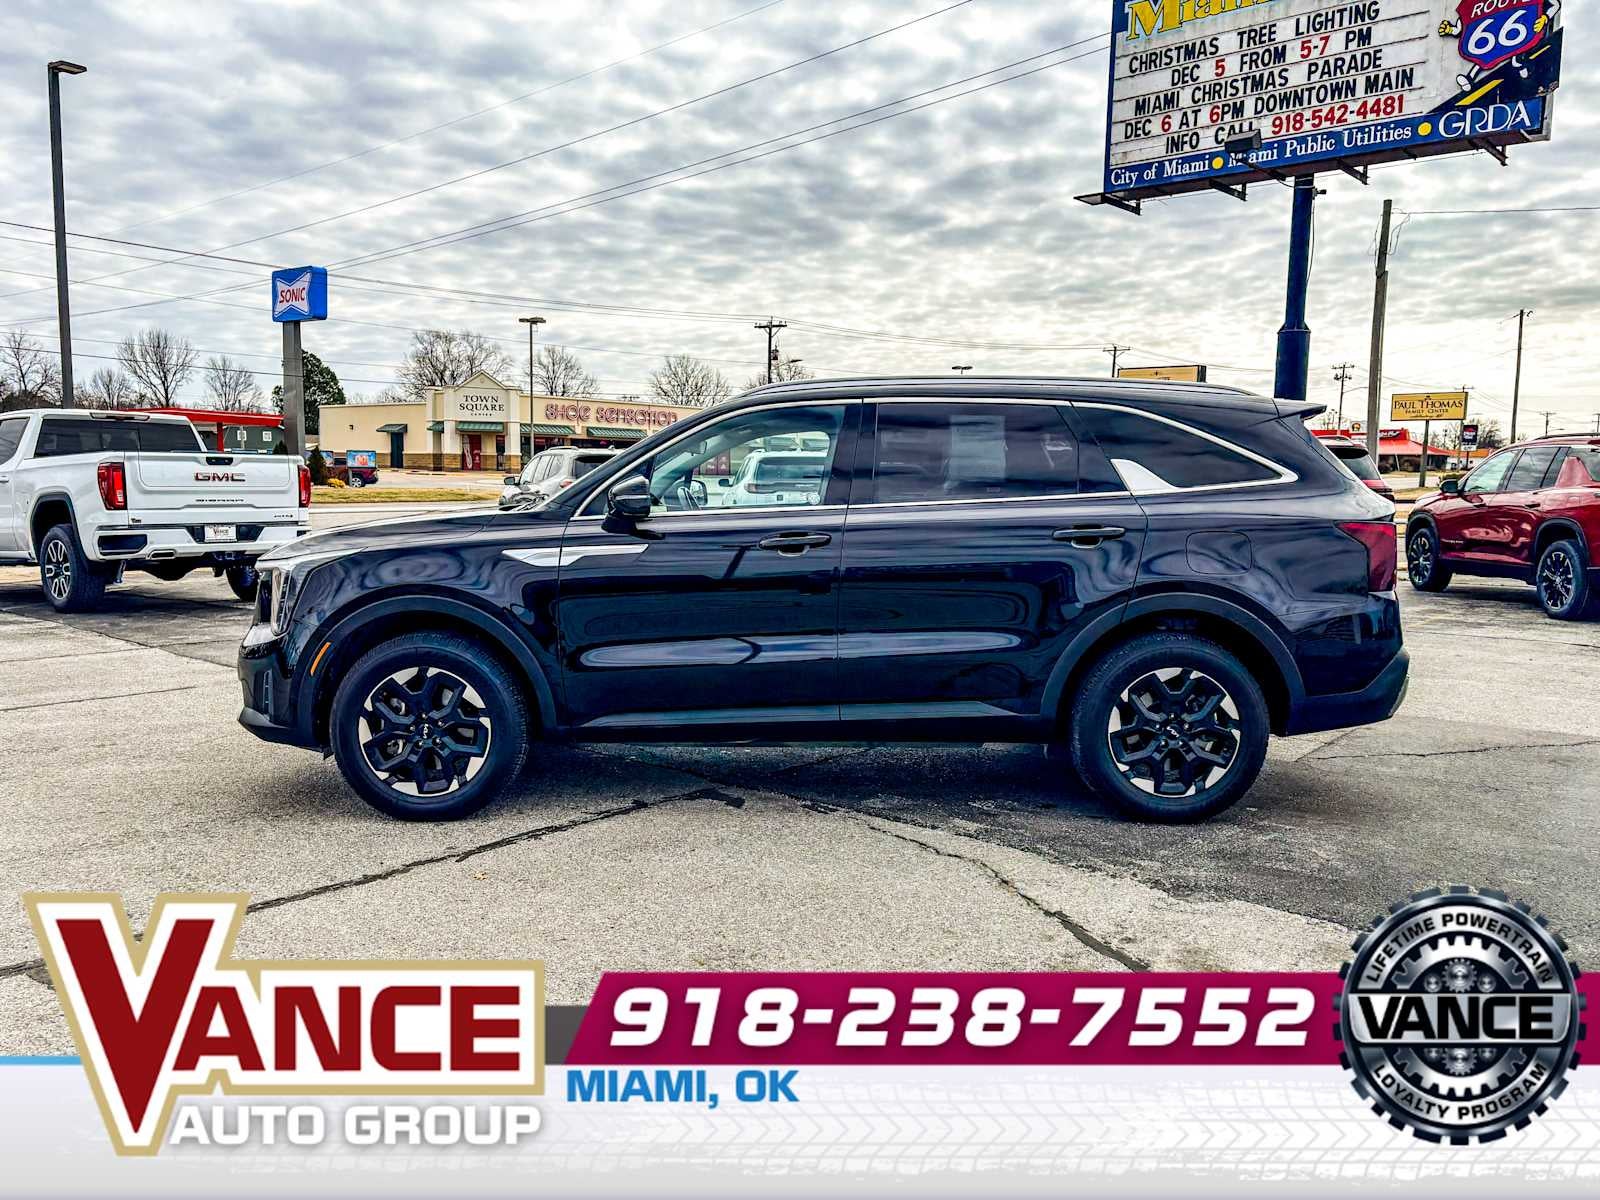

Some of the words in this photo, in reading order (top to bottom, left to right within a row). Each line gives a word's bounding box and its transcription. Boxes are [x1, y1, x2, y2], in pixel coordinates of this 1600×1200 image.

[1470, 0, 1531, 18] ROU
[1129, 37, 1220, 74] CHRISTMAS
[1237, 23, 1277, 49] TREE
[1295, 1, 1380, 36] LIGHTING
[1467, 10, 1528, 55] 66
[1171, 64, 1200, 87] DEC
[1214, 58, 1226, 78] 5
[1239, 45, 1287, 73] FROM
[1300, 35, 1331, 59] 5-7
[1344, 26, 1373, 50] PM
[1134, 91, 1180, 117] MIAMI
[1191, 68, 1289, 104] CHRISTMAS
[1307, 49, 1383, 81] PARADE
[1124, 119, 1152, 139] DEC
[1161, 114, 1172, 133] 6
[1178, 109, 1202, 130] AT
[1209, 100, 1245, 124] 6PM
[1254, 79, 1357, 115] DOWNTOWN
[1364, 67, 1414, 95] MAIN
[1438, 100, 1532, 138] GRDA
[1165, 131, 1200, 154] INFO
[1271, 94, 1405, 135] 918-542-4481
[1285, 133, 1336, 158] Public
[1342, 124, 1412, 149] Utilities
[1111, 168, 1138, 188] City
[1143, 164, 1158, 180] of
[1163, 155, 1210, 178] Miami
[279, 287, 306, 304] SONIC
[459, 403, 505, 412] SQUARE
[463, 395, 499, 403] TOWN
[1394, 400, 1416, 409] PAUL
[1420, 399, 1464, 409] THOMAS
[195, 472, 246, 482] GMC
